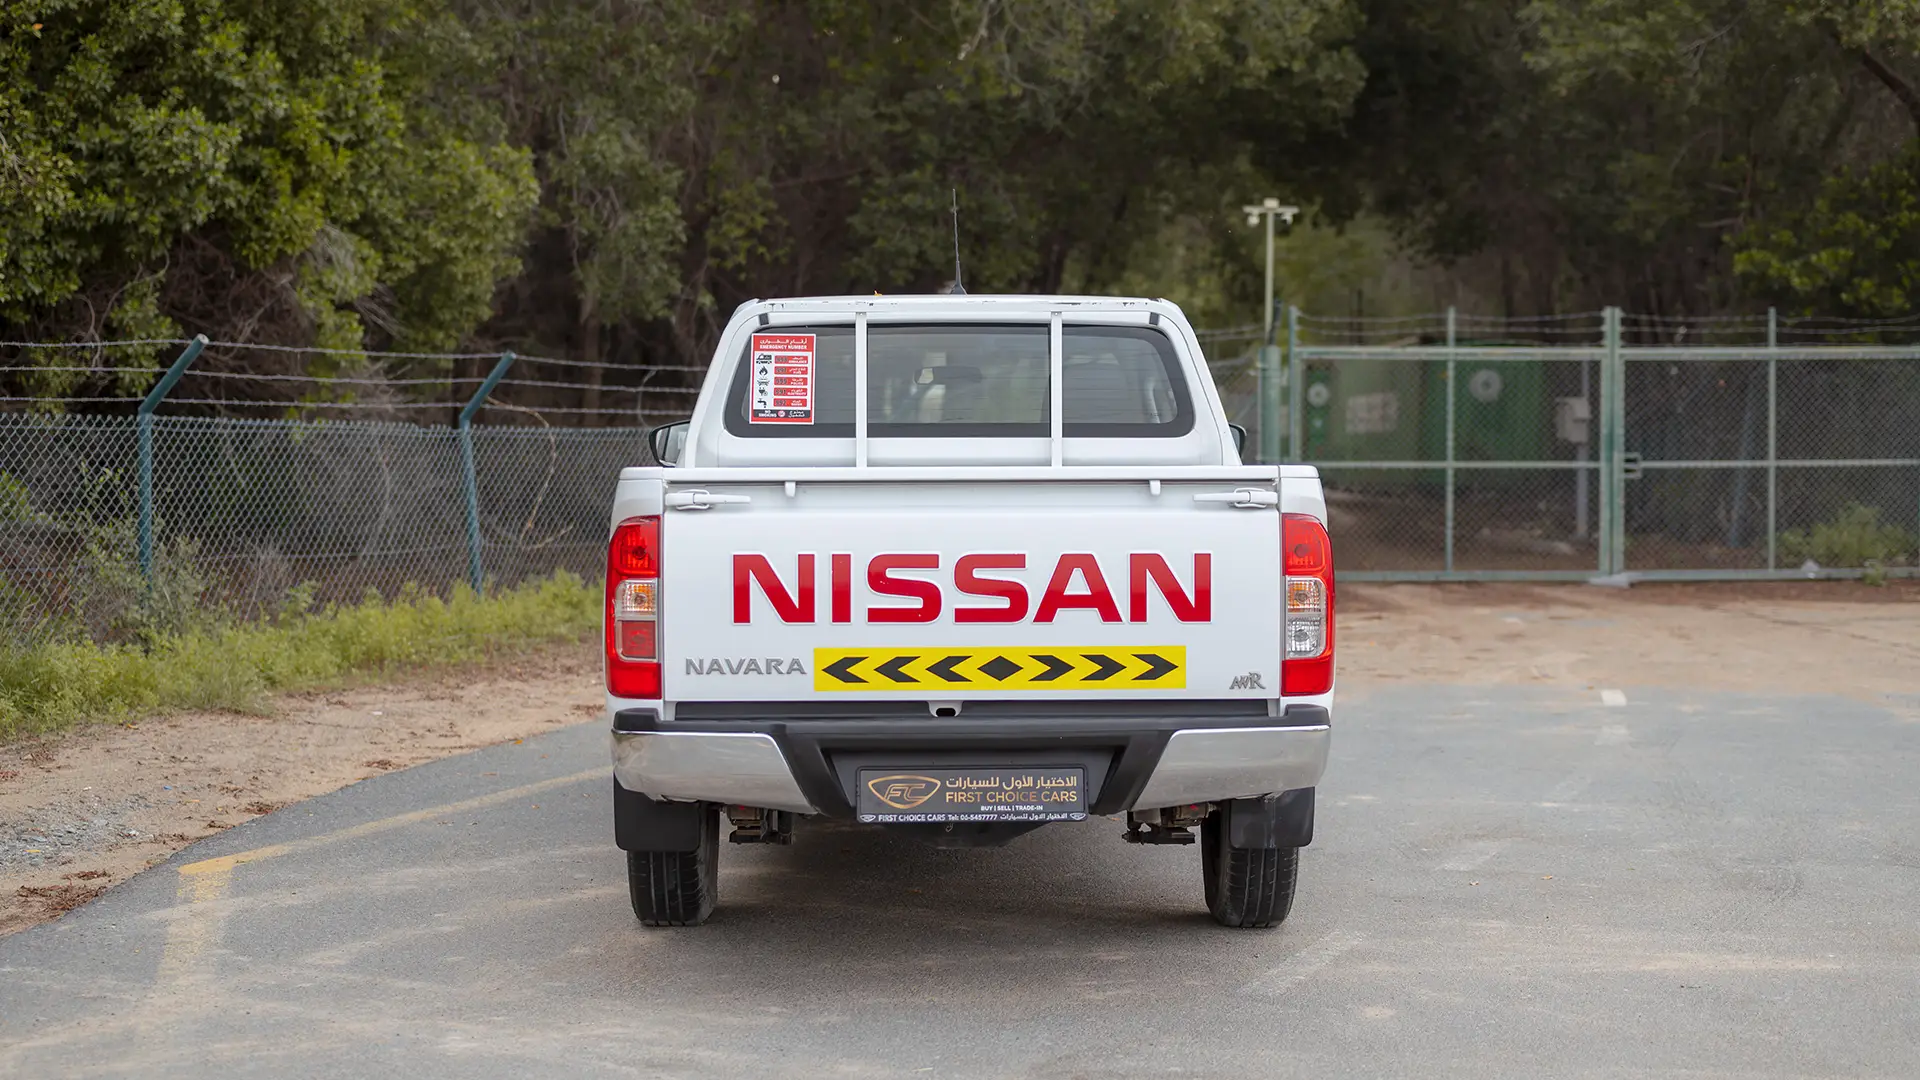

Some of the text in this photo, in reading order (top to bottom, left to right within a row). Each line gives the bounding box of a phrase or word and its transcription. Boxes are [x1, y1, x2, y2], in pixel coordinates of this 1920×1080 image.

[731, 551, 1213, 625] NISSAN
[685, 656, 807, 676] NAVARA
[945, 775, 1077, 790] الاختيار الأول للسيارات
[945, 791, 1077, 803] FIRST CHOICE CARS
[878, 814, 897, 822] FIRST
[898, 814, 926, 822] CHOICE
